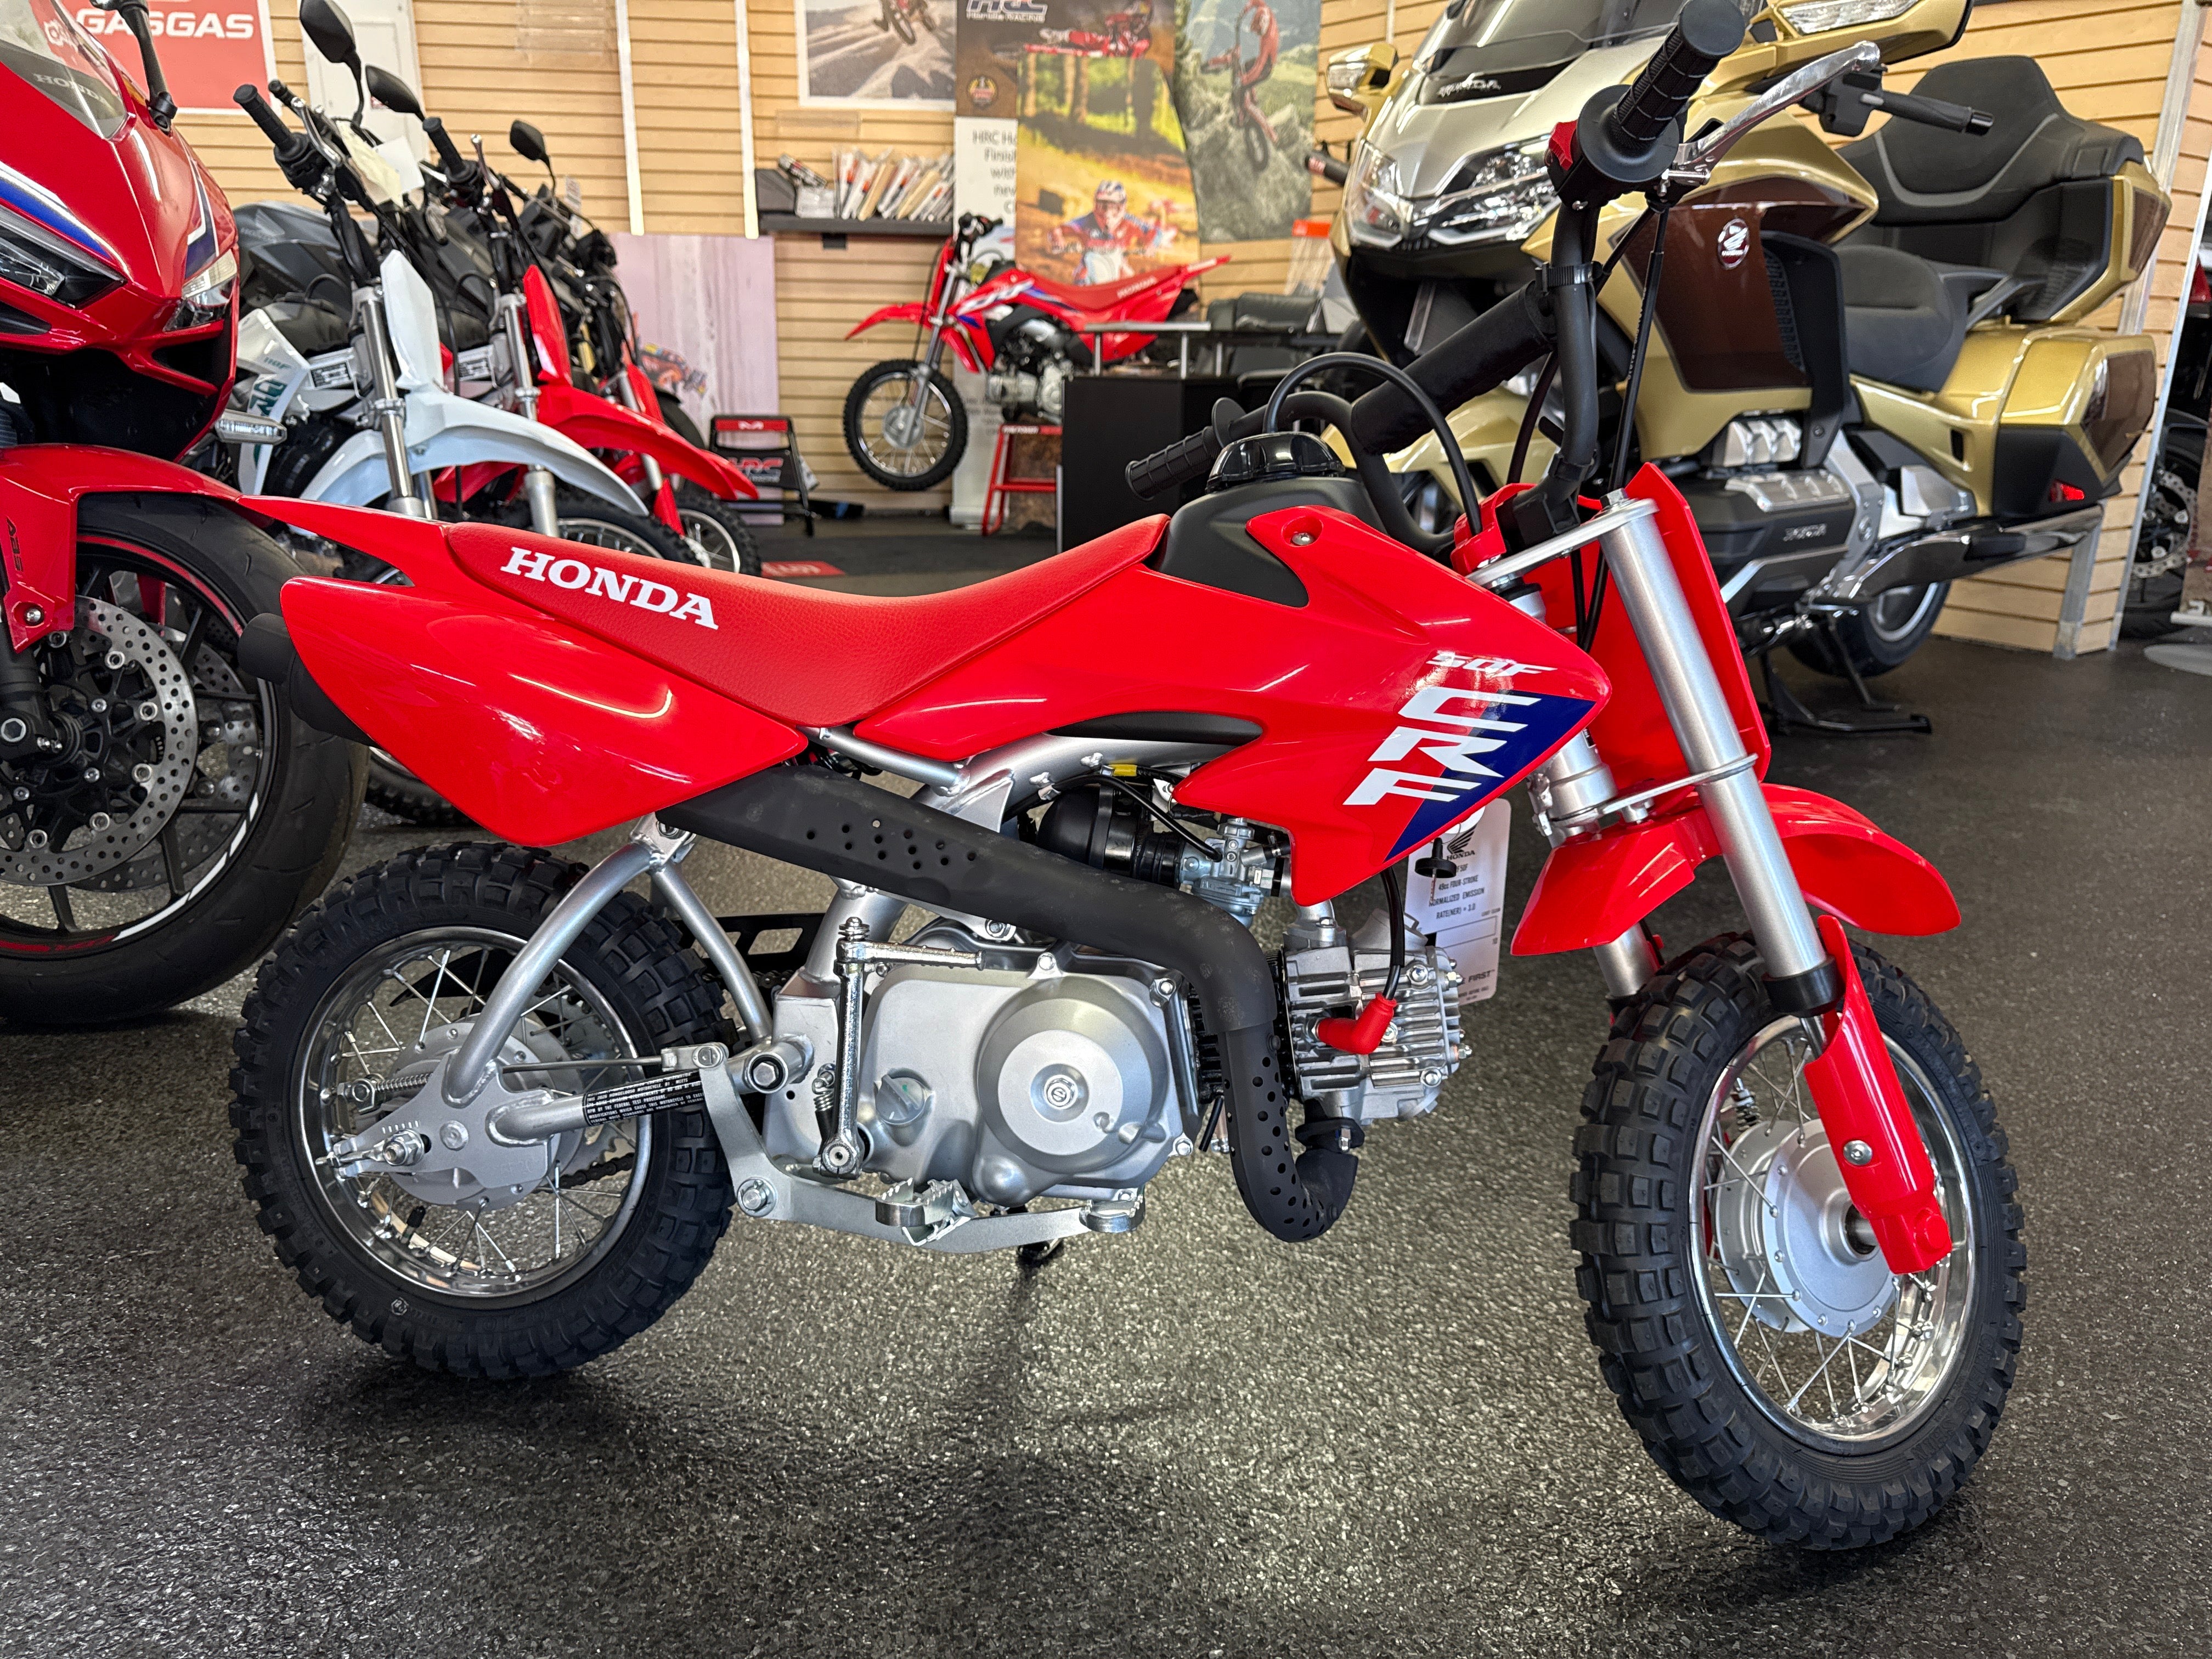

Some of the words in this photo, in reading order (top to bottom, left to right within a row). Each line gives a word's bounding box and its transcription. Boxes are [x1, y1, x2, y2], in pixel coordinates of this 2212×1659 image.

[76, 8, 253, 40] GASGAS
[5, 516, 24, 572] ABS
[500, 546, 719, 630] HONDA
[1426, 650, 1559, 678] 50F
[1342, 686, 1543, 805] CRF
[1446, 850, 1476, 861] HONDA
[1449, 874, 1479, 888] FOUR-STROKE
[1429, 894, 1460, 907] NORMALIZED
[1462, 887, 1485, 900] EMISSION
[588, 1109, 617, 1119] MODIFICATIONS
[659, 1096, 684, 1105] MOTORCYCLE
